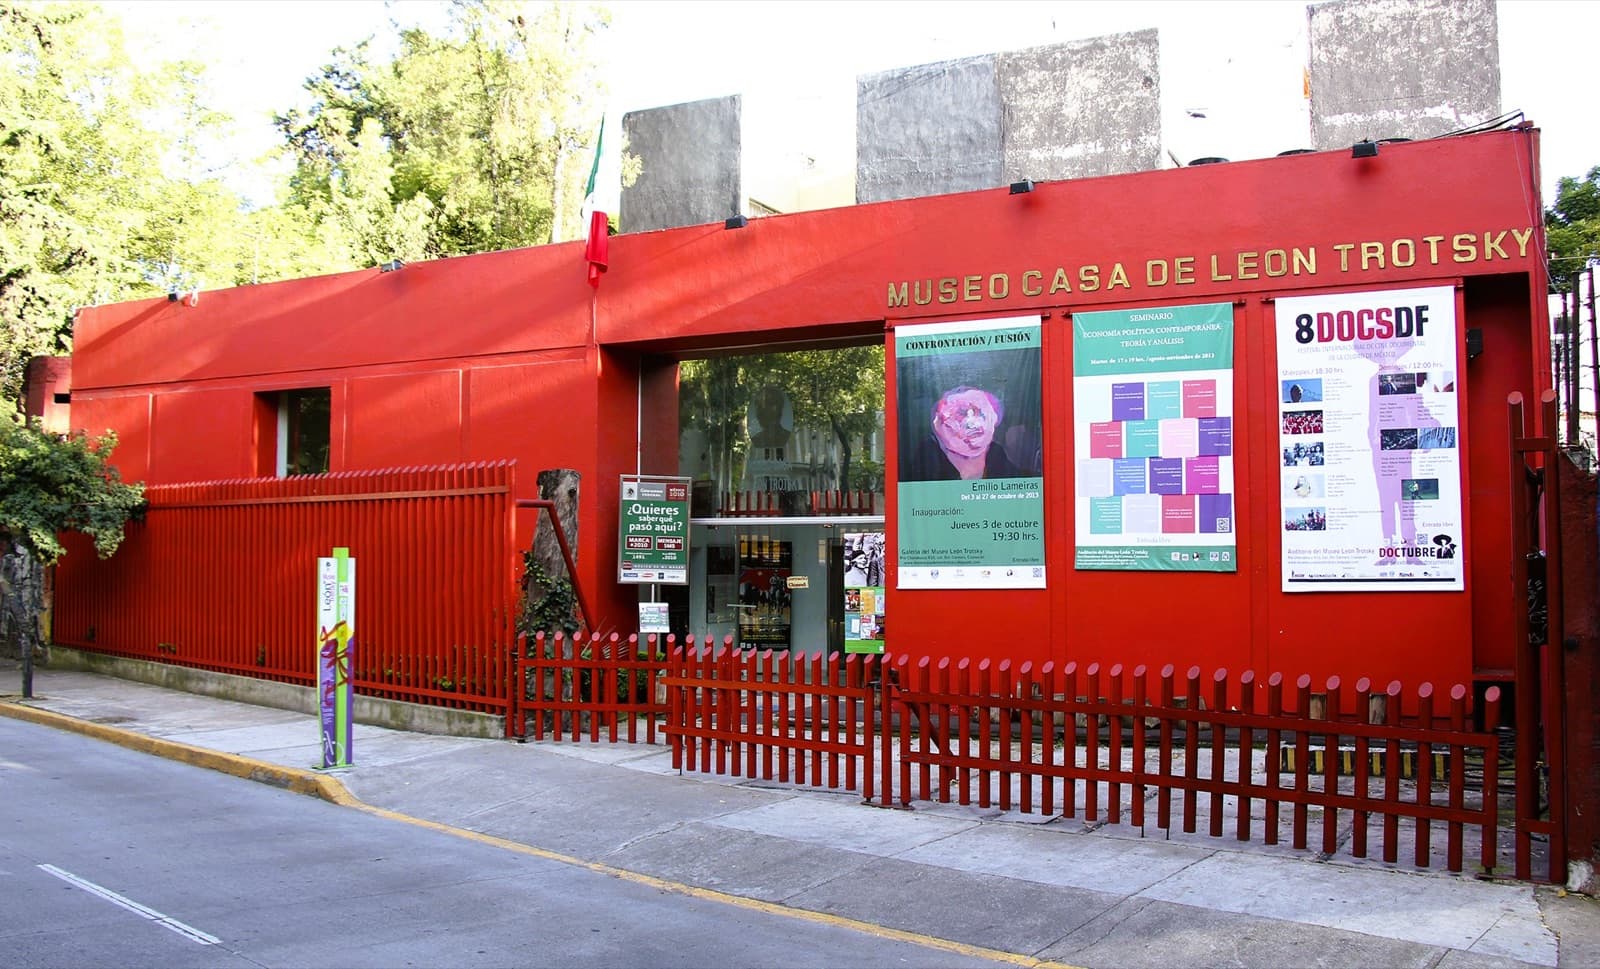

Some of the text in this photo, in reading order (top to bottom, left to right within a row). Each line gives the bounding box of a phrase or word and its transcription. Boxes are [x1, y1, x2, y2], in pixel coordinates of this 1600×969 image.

[888, 227, 1533, 307] MUSEO CASA DE LEON TROTSKY
[1130, 312, 1173, 322] SEMINARIO
[1295, 305, 1429, 344] 8DOCSDF
[1083, 323, 1221, 338] ECONOMÍA POLÍTICA CONTEMPORÁNEA
[906, 331, 1032, 351] CONFRONTACIÓN / FUSIÓN
[1120, 339, 1146, 348] TEORÍA
[1153, 337, 1184, 346] ANÁLISIS
[972, 481, 1038, 491] Emilio Lameiras
[627, 503, 680, 516] ¿Quieres
[912, 507, 964, 517] Inauguración:
[639, 515, 673, 524] saber qué
[951, 520, 1038, 530] Jueves 3 de octubre
[629, 521, 683, 534] pasó aquí?
[993, 532, 1039, 541] 19:30 hrs.
[1379, 547, 1436, 558] DOCTUBRE
